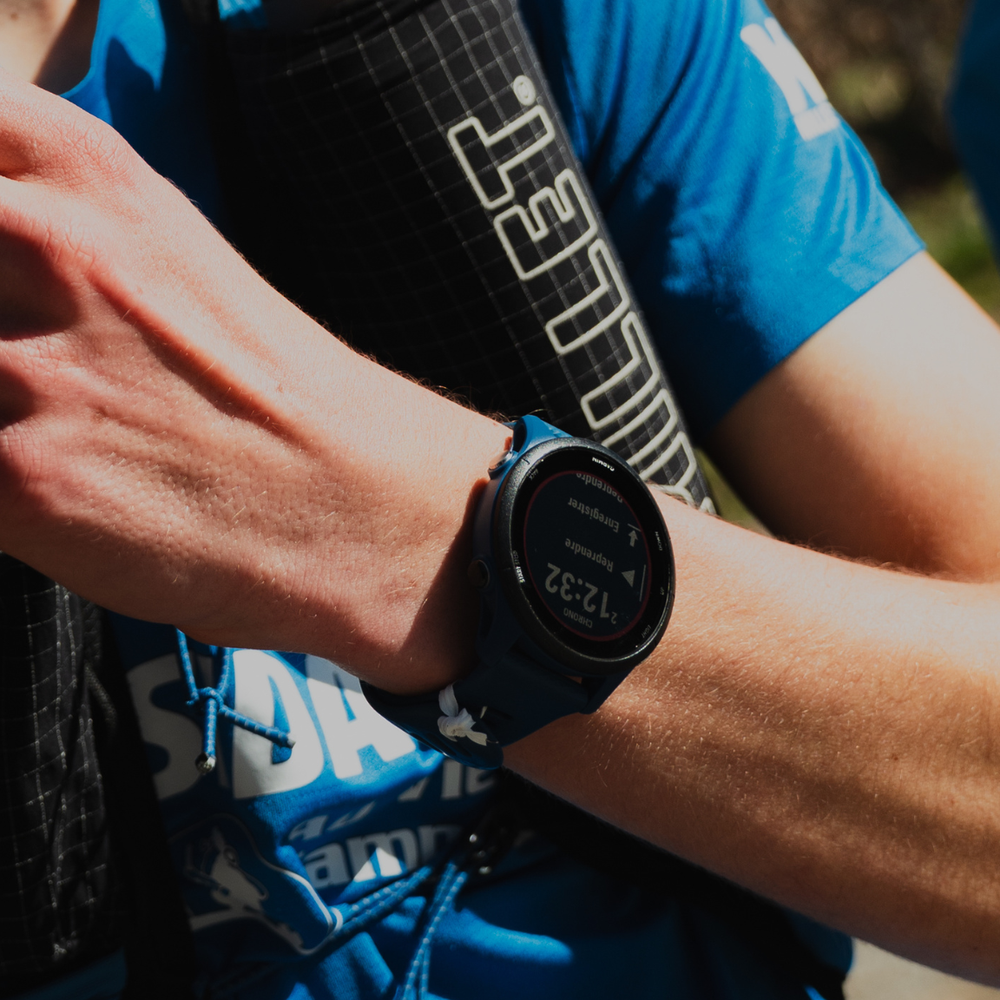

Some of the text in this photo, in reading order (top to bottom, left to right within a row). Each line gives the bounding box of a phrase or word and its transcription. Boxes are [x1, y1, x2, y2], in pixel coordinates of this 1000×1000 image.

[567, 497, 620, 533] Enregistrer
[564, 538, 614, 573] Reprendre
[544, 562, 611, 619] 12:32
[563, 607, 593, 628] CHRONO
